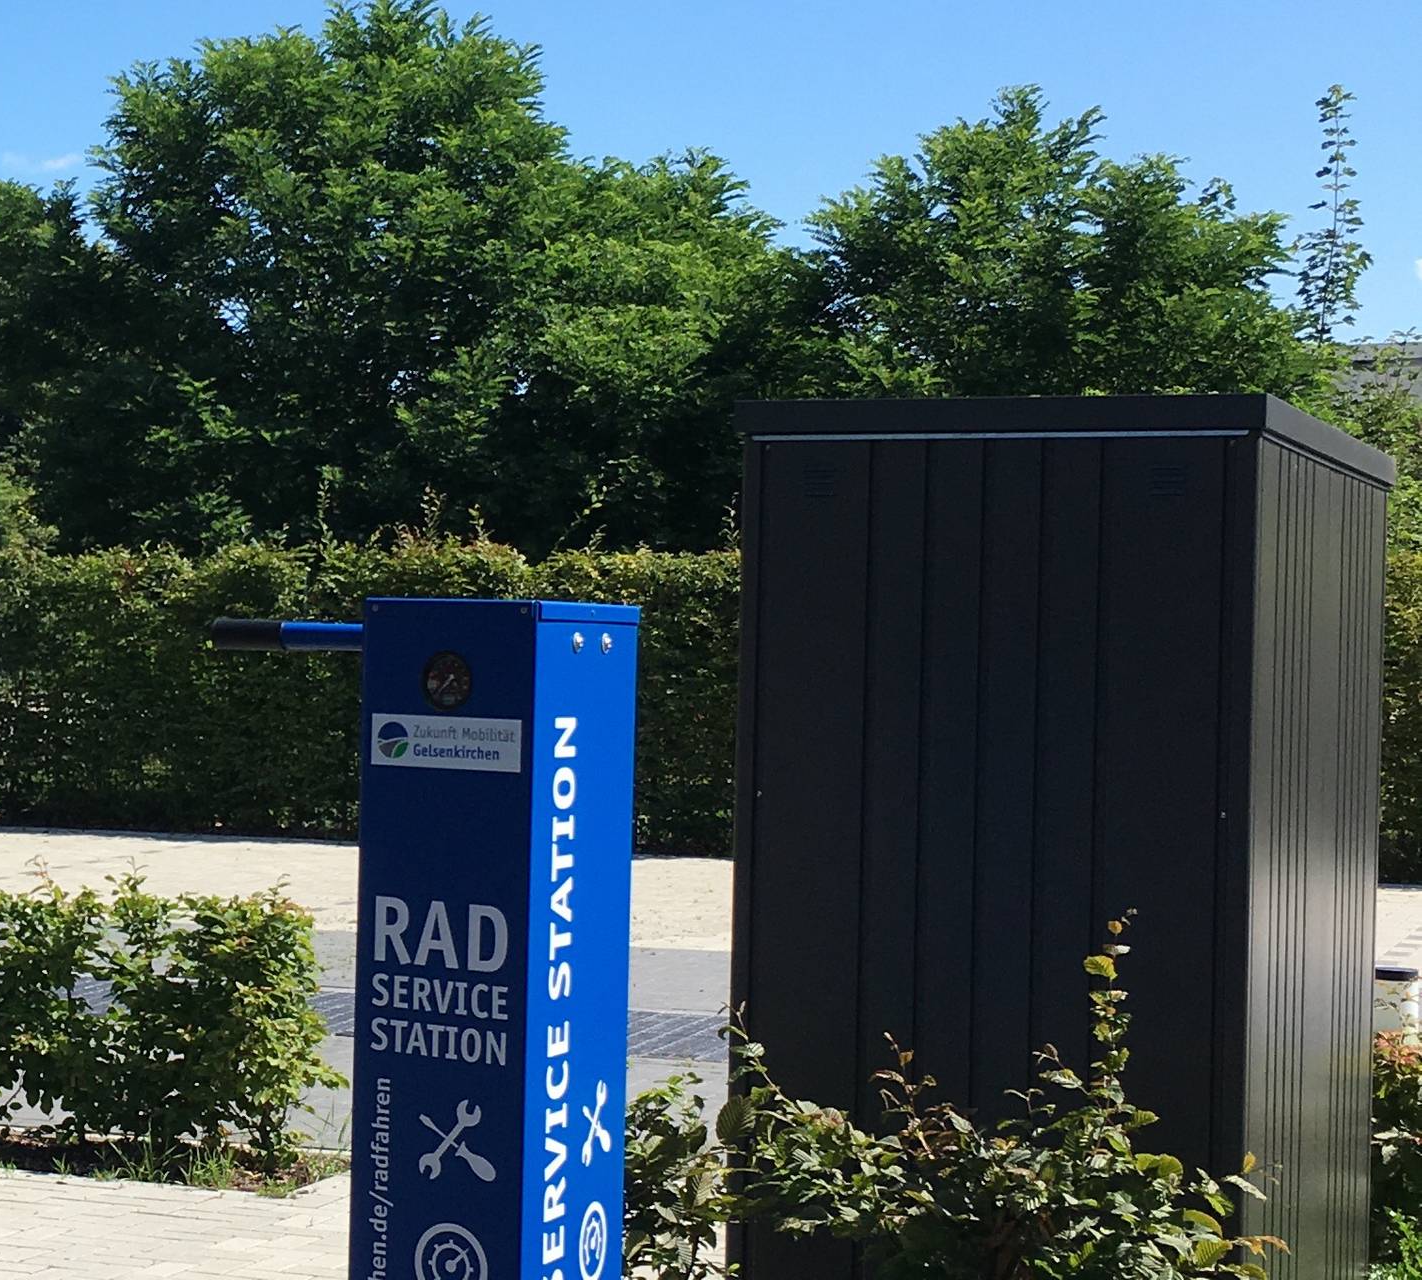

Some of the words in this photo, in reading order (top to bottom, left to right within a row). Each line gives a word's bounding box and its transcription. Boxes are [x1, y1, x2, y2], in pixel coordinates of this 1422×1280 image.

[413, 724, 457, 740] Zukunft
[462, 727, 516, 743] Mobilität
[413, 743, 500, 761] Gelsenkirchen
[547, 717, 577, 1001] STATION
[372, 895, 509, 973] RAD
[371, 973, 509, 1021] SERVICE
[369, 1017, 508, 1066] STATION
